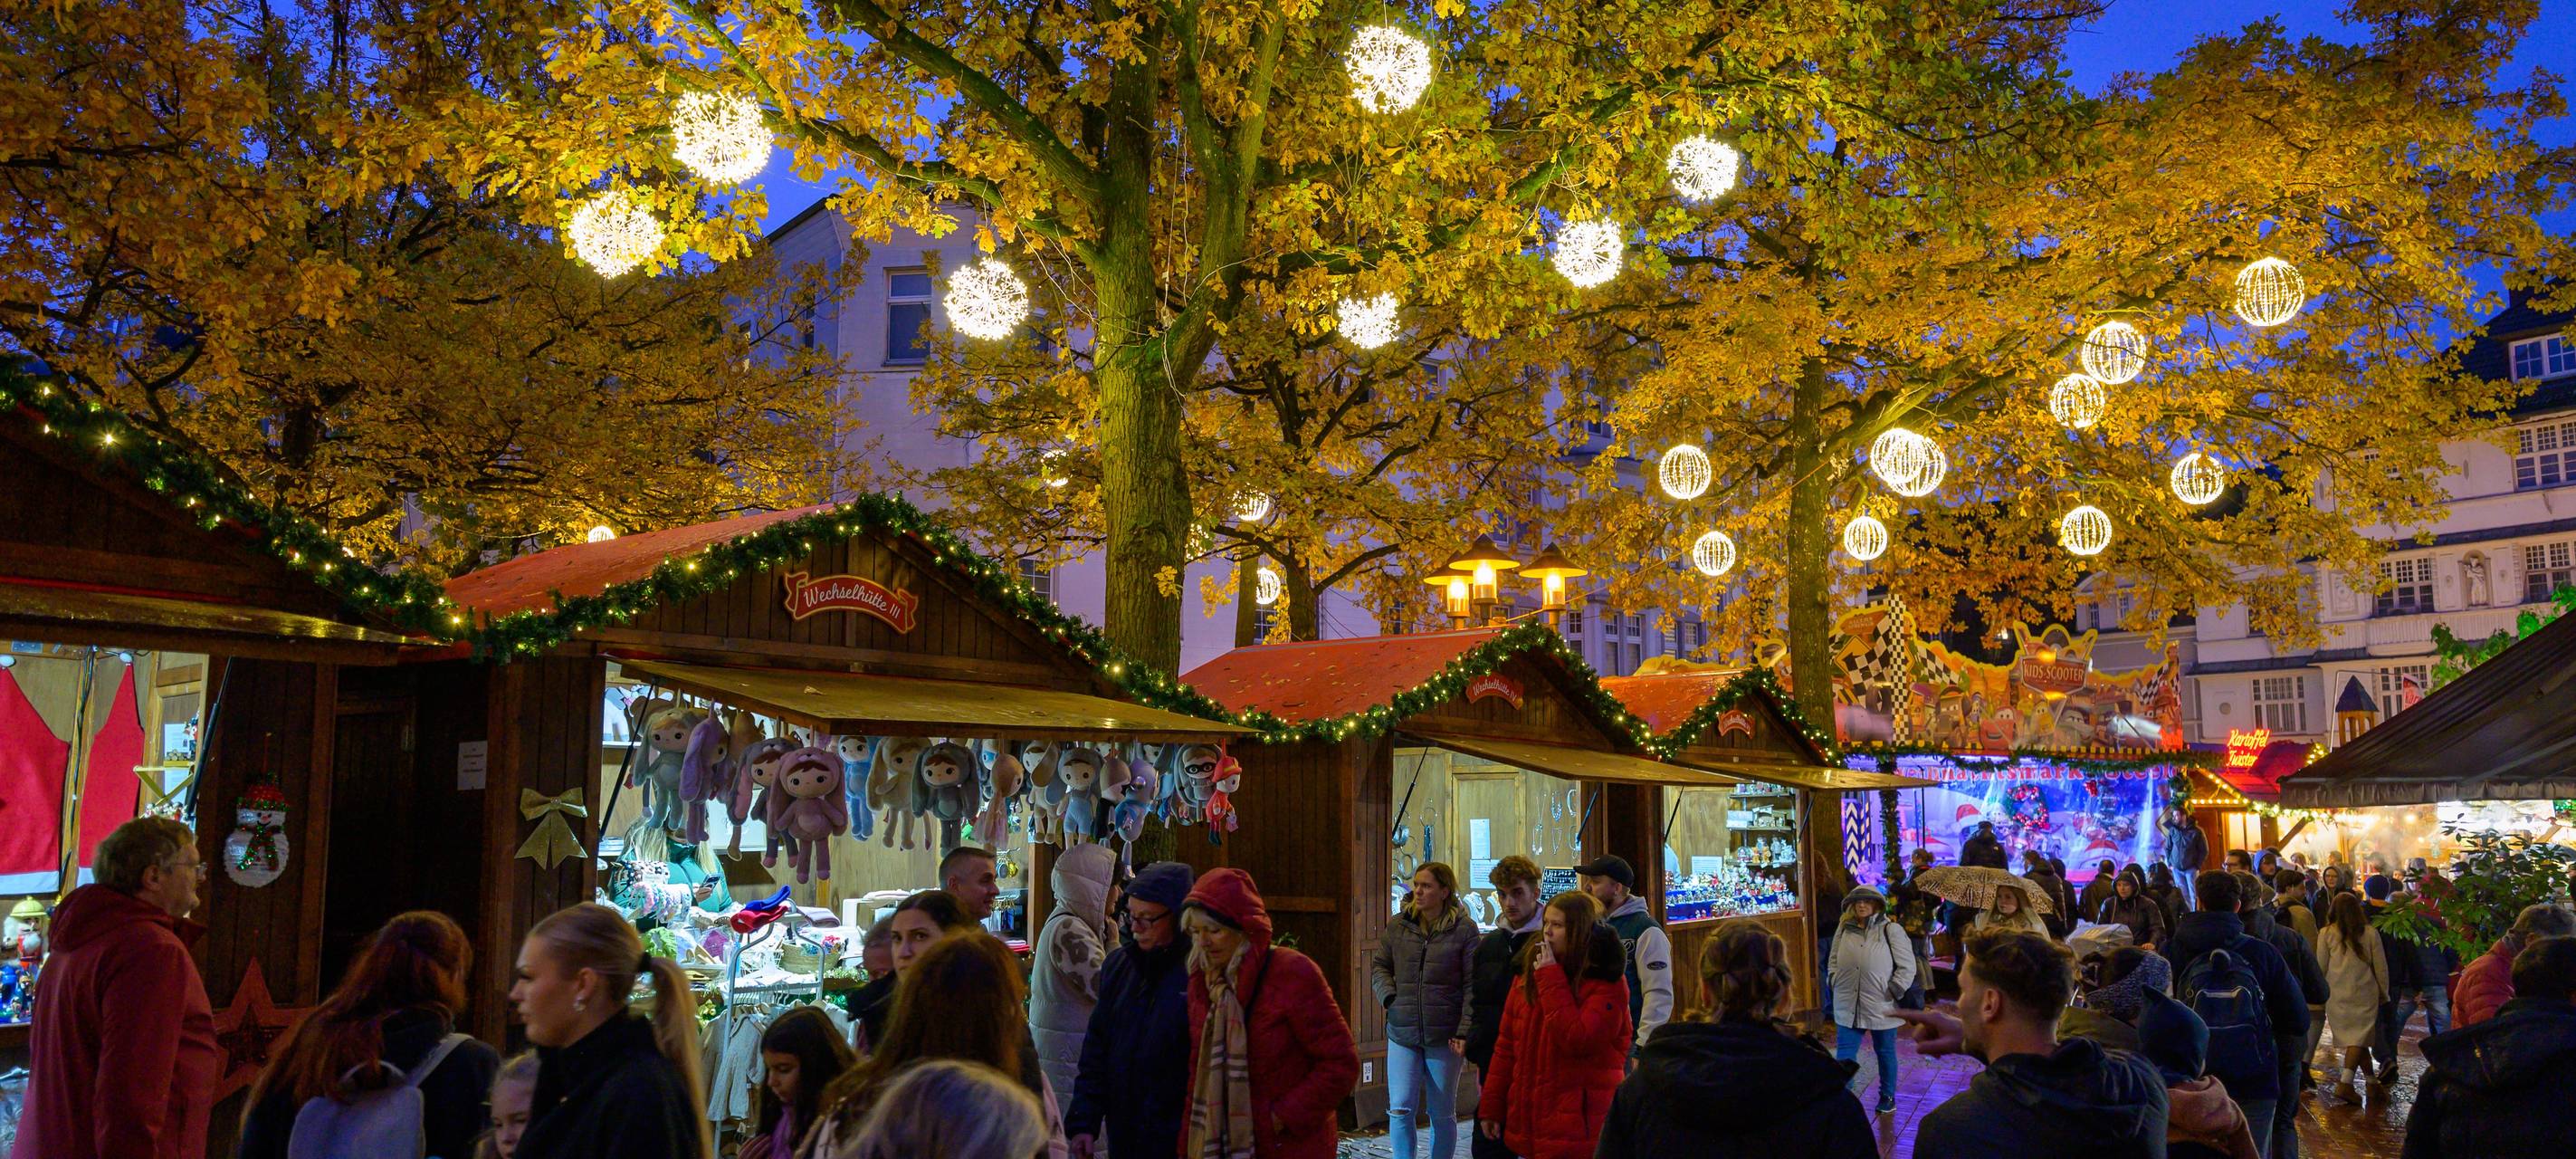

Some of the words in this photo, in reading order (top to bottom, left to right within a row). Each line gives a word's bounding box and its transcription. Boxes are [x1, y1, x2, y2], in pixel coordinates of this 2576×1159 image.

[804, 582, 888, 611] Wechselhütte
[889, 603, 902, 618] III
[2228, 728, 2270, 750] Kartoffel
[2226, 750, 2257, 767] Twister
